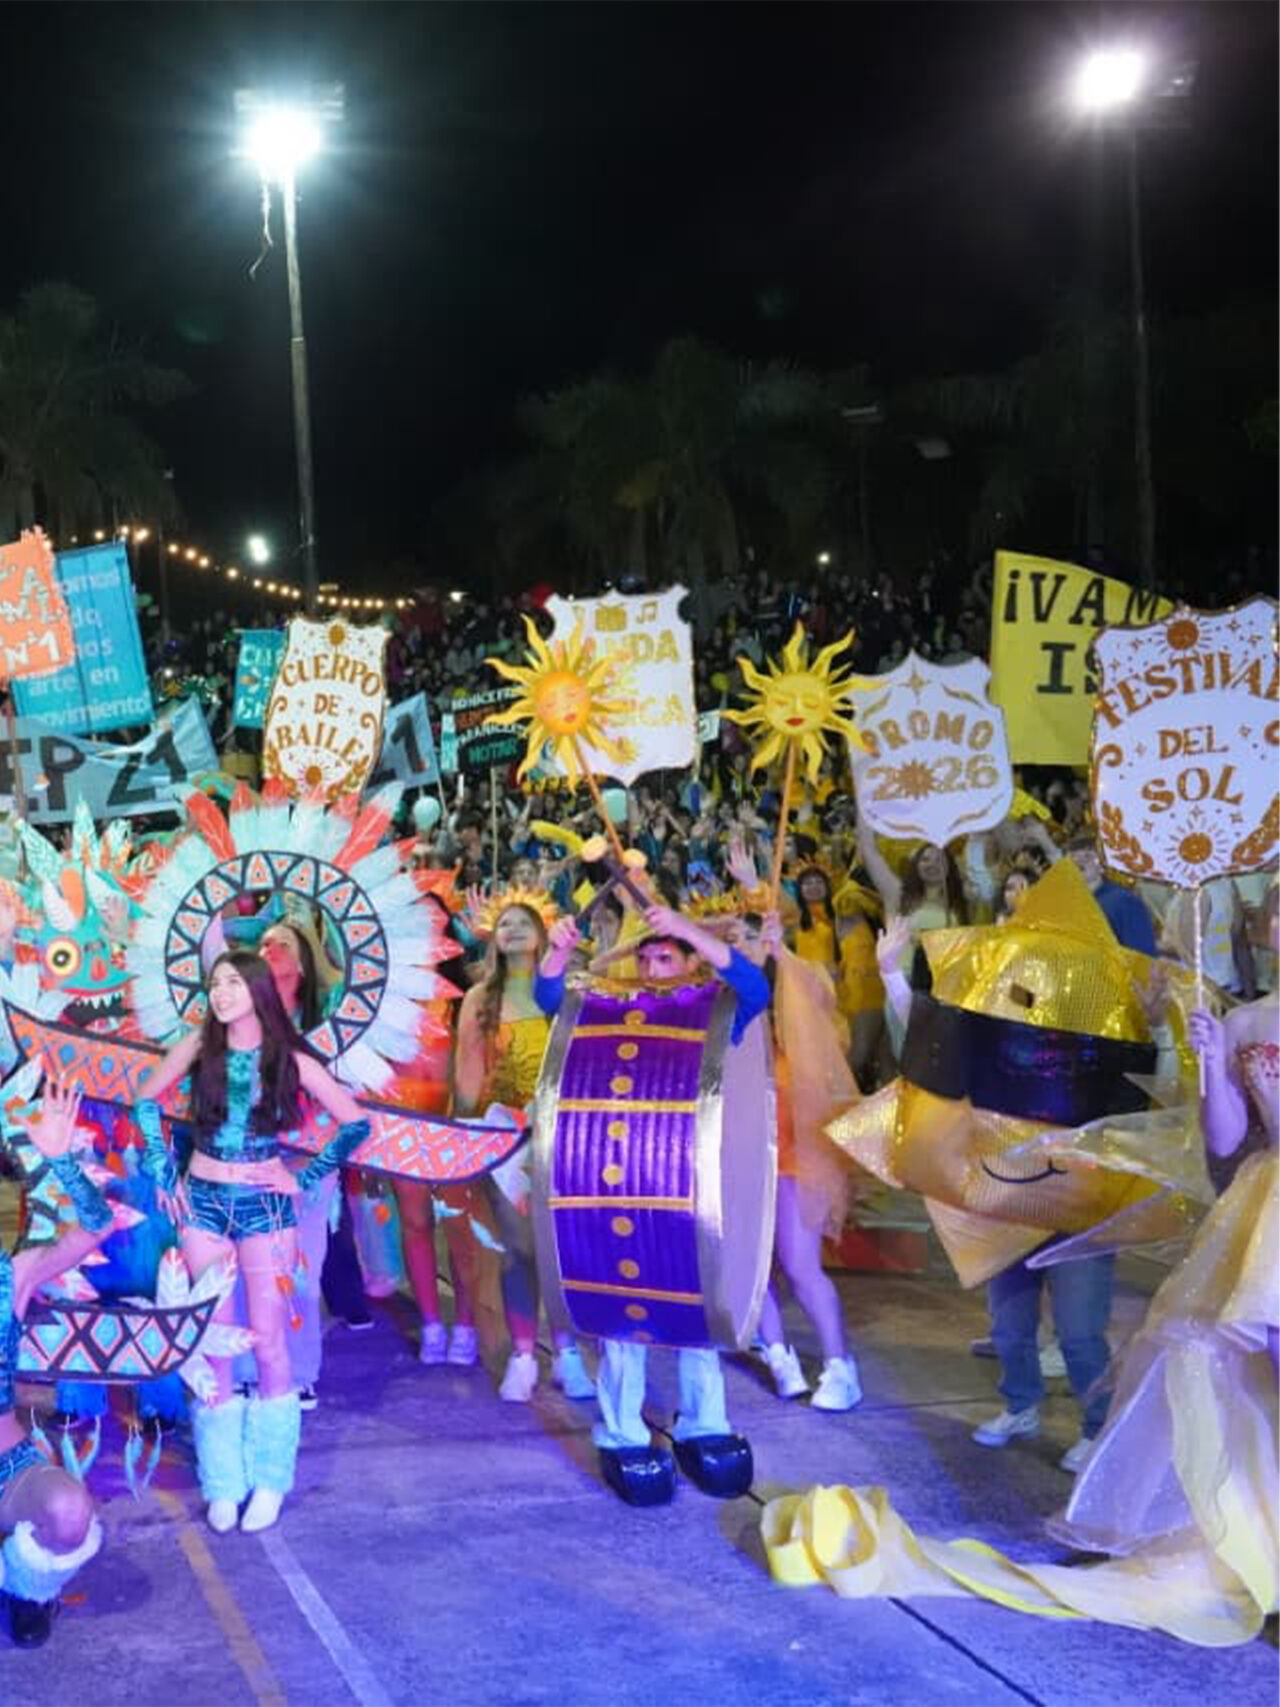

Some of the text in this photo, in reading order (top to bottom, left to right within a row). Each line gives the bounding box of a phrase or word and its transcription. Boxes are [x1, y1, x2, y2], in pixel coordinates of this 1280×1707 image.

[90, 667, 119, 686] en
[282, 652, 382, 697] CUERPO
[314, 692, 340, 717] DE
[276, 722, 364, 764] BAILE
[861, 710, 994, 758] PROMO
[1158, 725, 1230, 760] DEL
[1141, 763, 1244, 813] SOL
